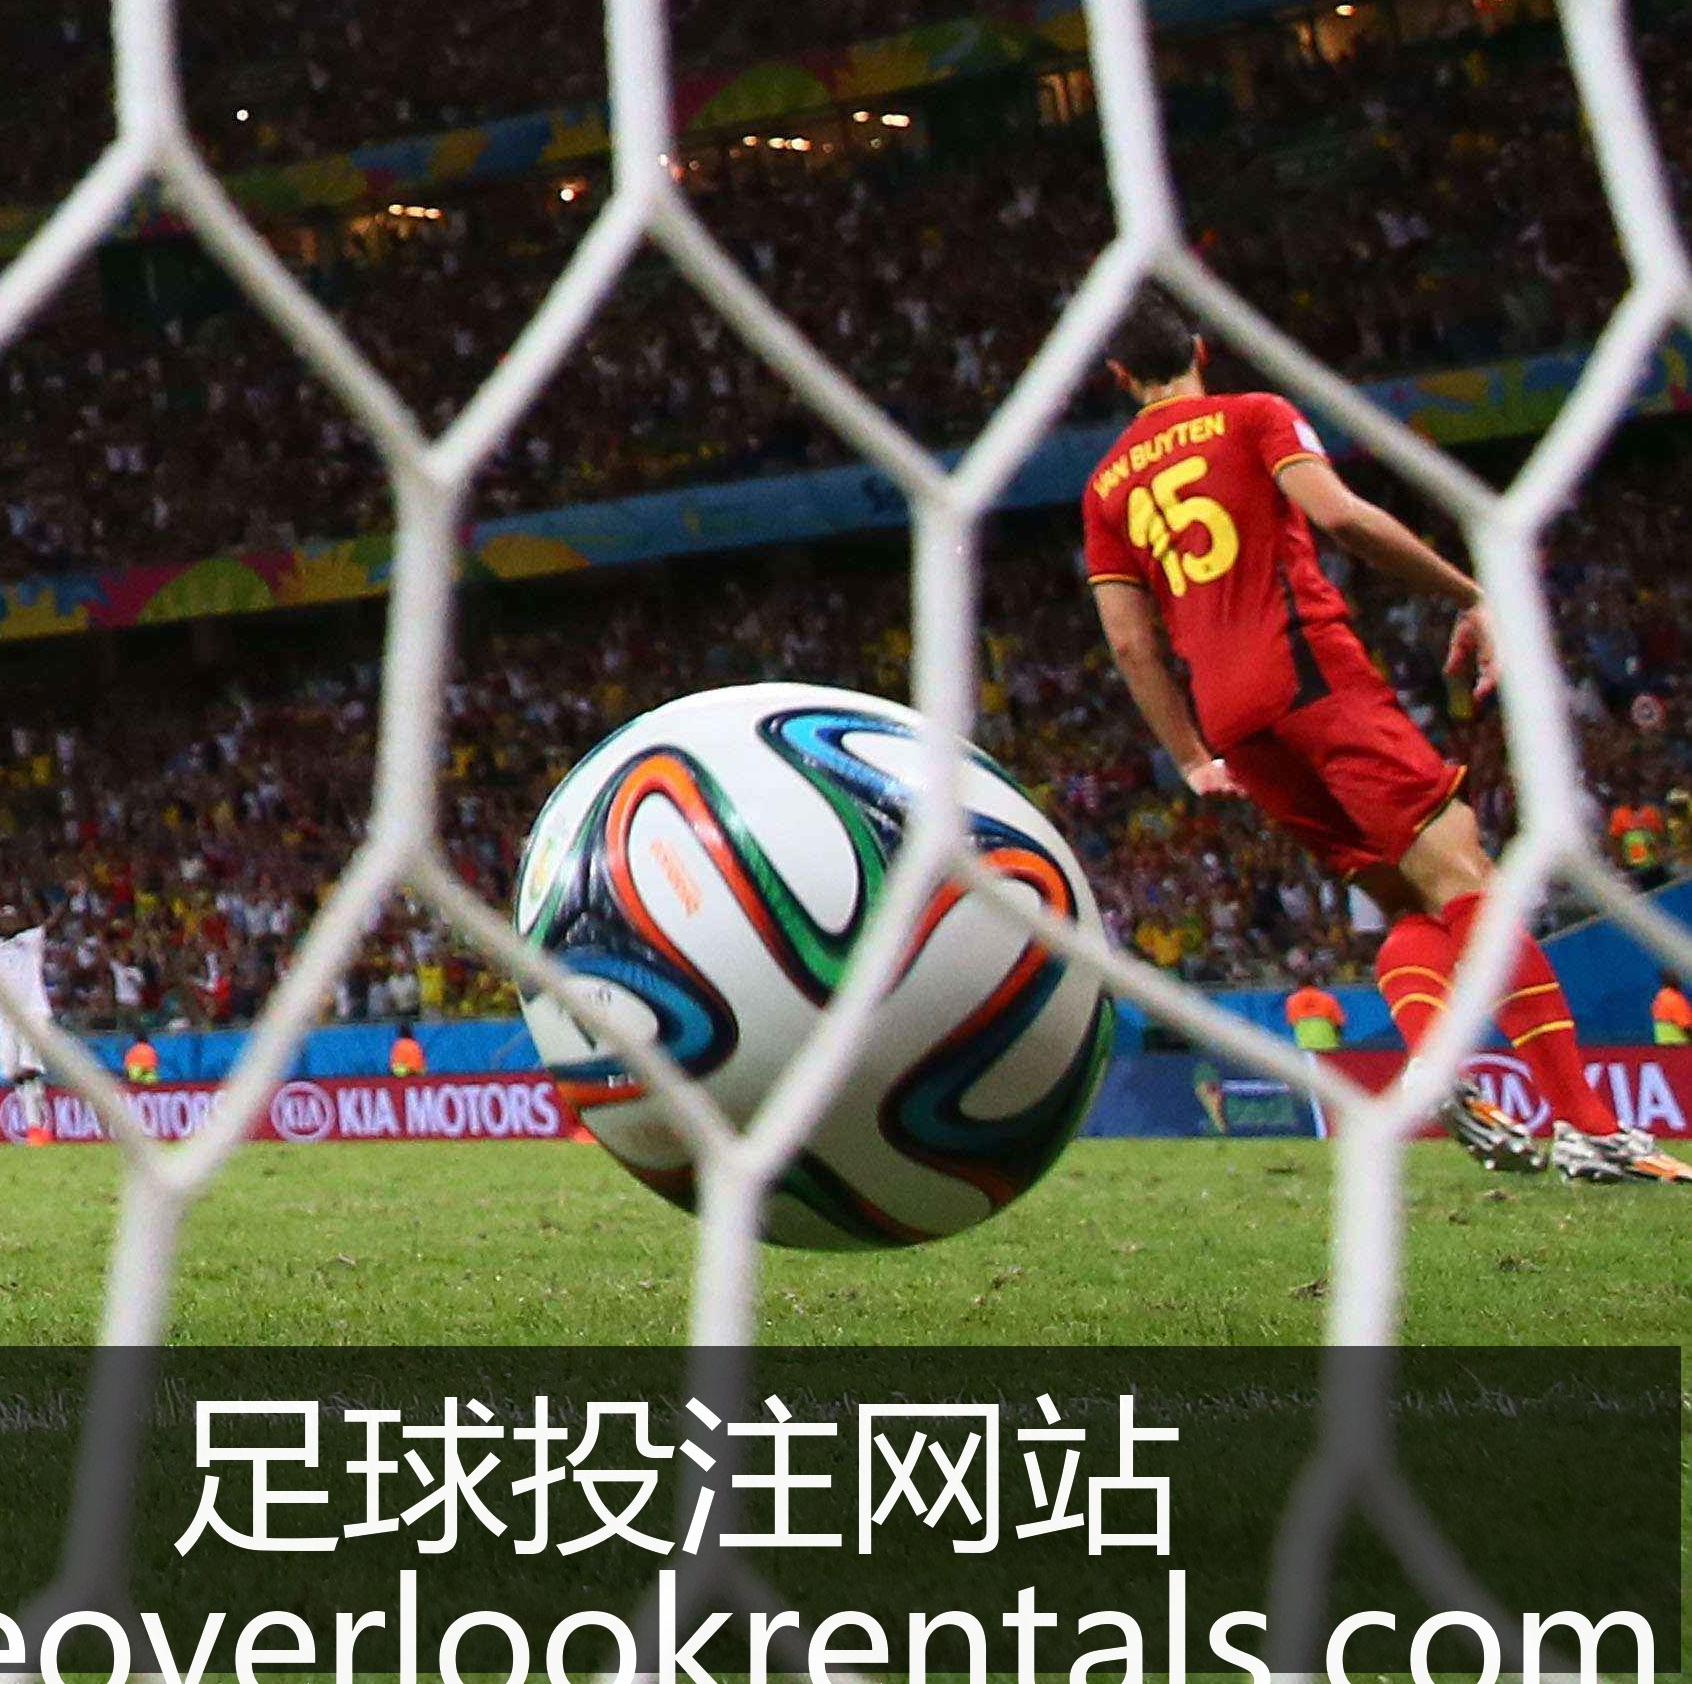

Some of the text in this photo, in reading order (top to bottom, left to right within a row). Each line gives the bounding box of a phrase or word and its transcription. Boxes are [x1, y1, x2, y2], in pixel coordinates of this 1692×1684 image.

[1129, 411, 1227, 473] BUYTEN
[1127, 454, 1241, 598] 15
[337, 1086, 400, 1137] KIA
[405, 1081, 560, 1138] MOTORS
